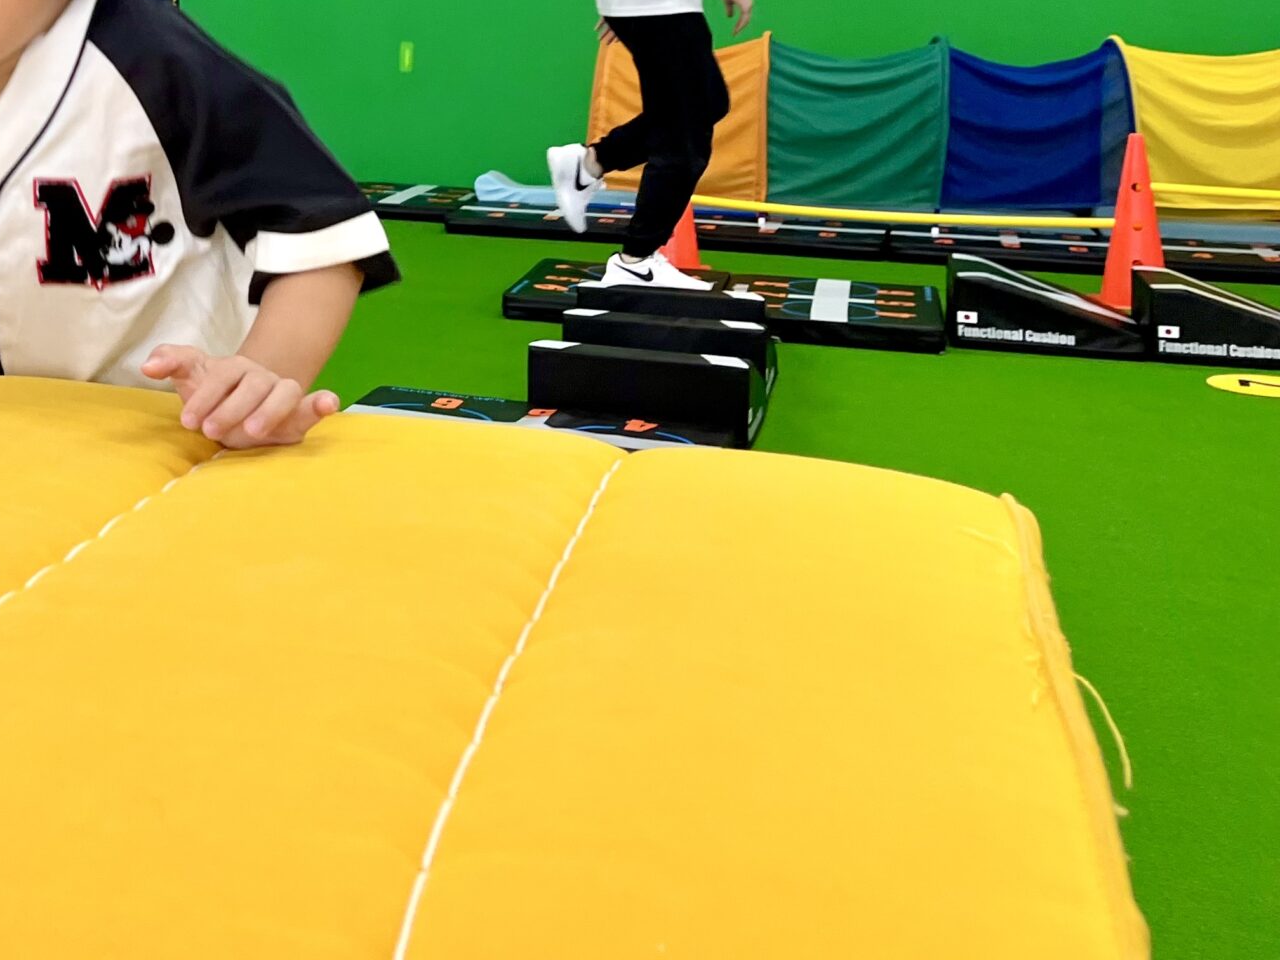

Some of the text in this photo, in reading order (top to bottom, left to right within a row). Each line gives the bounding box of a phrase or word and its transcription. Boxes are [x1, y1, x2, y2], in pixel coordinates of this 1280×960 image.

[33, 173, 155, 291] M
[957, 324, 1076, 346] Functional Cushion
[1158, 339, 1228, 357] Functional
